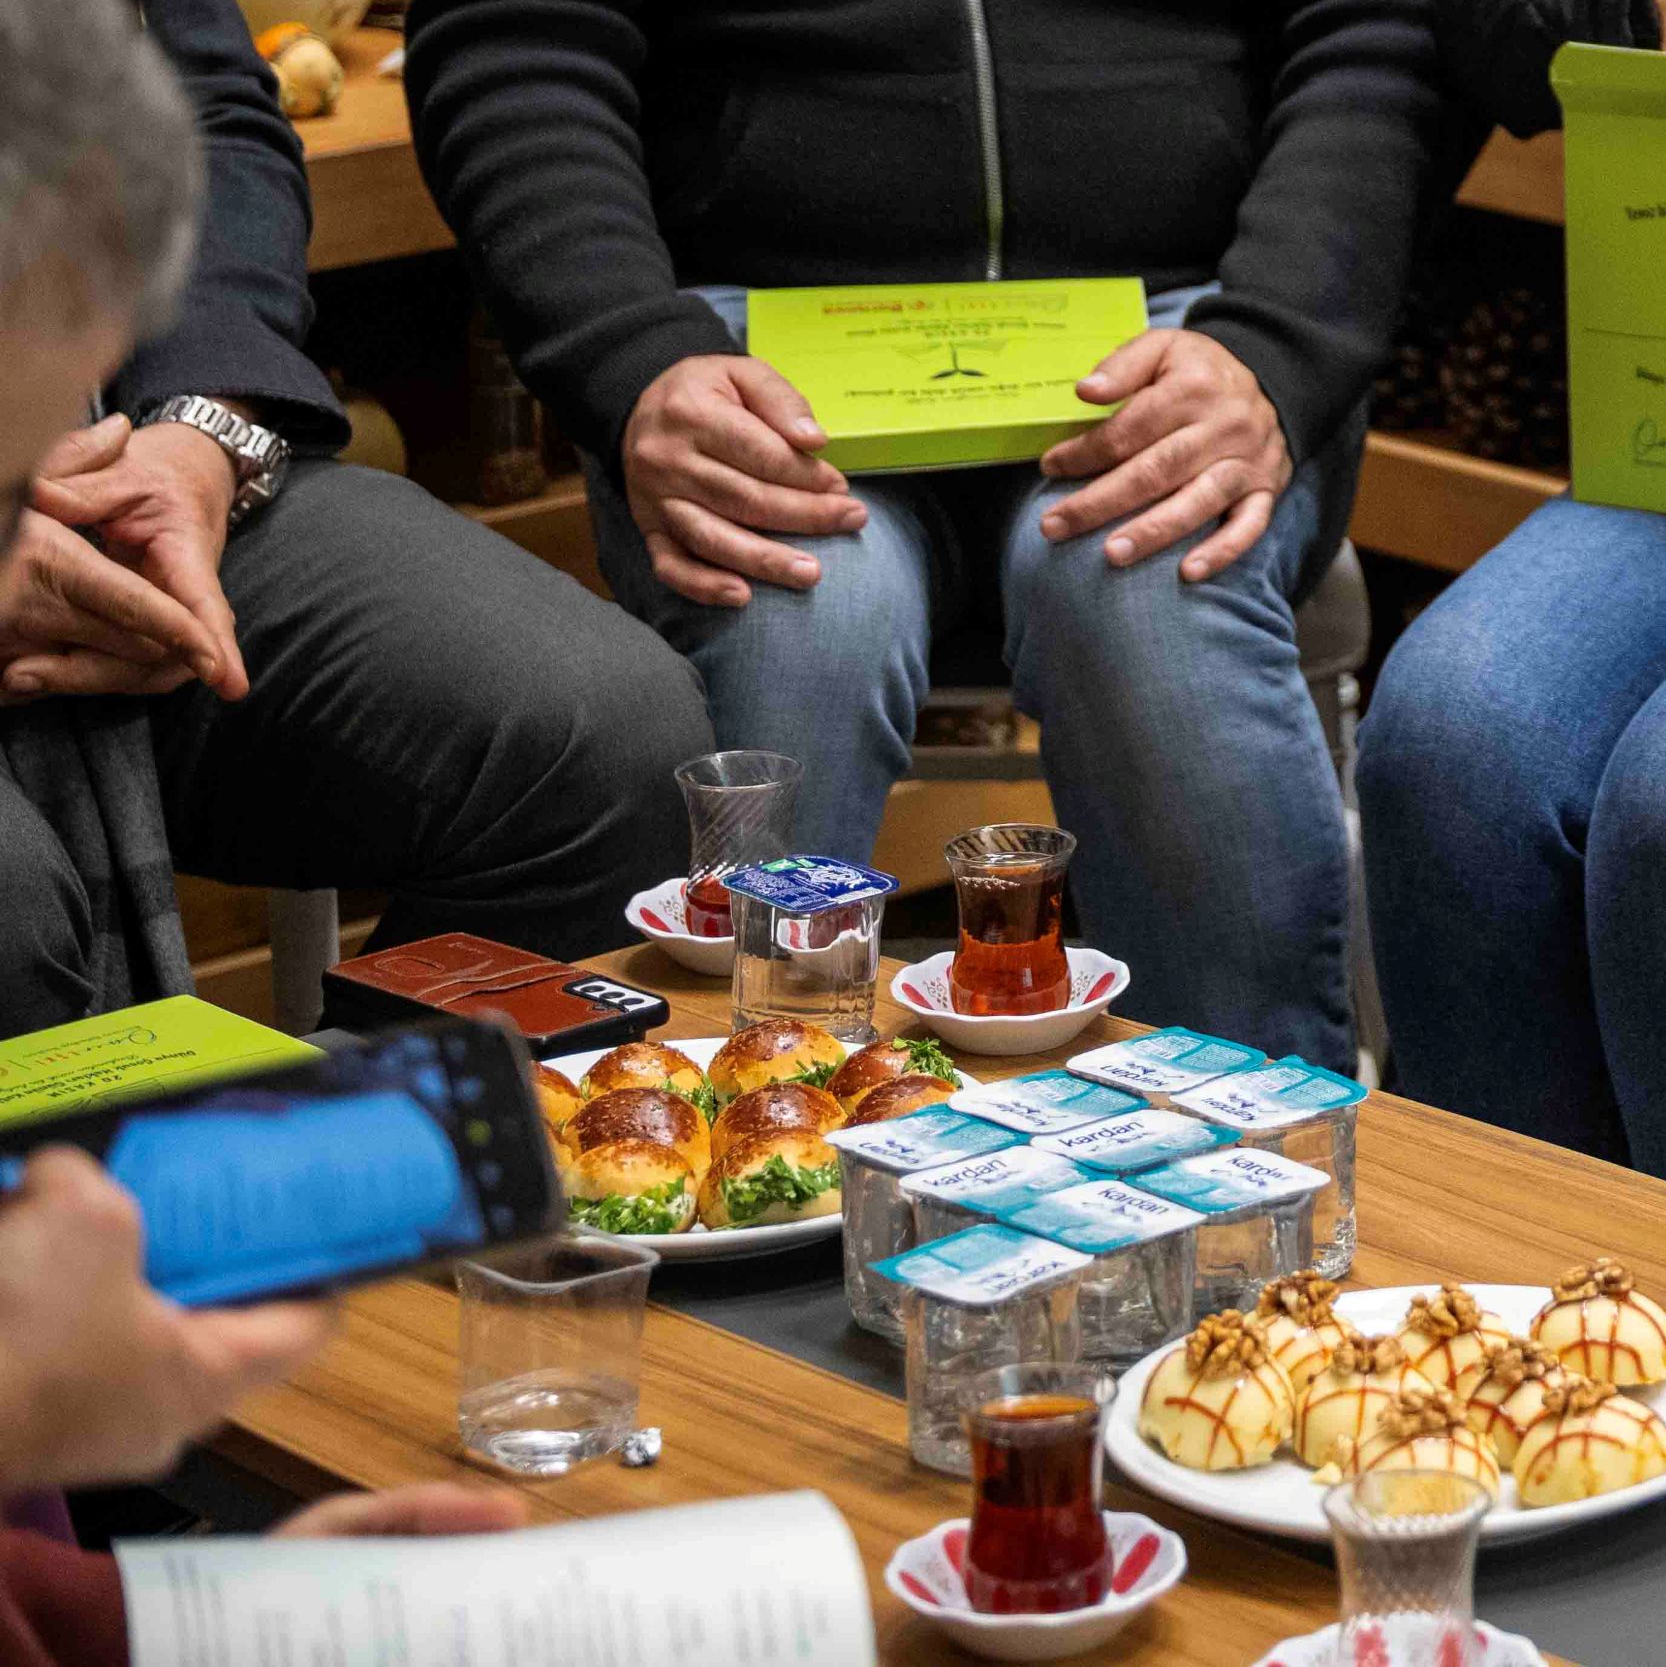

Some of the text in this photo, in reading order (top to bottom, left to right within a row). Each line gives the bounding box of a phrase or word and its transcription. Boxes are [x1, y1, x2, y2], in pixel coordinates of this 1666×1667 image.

[153, 1049, 196, 1063] Dünya
[46, 1081, 95, 1099] KASIM
[1058, 1119, 1146, 1148] kardan
[922, 1156, 1008, 1187] kardan
[1097, 1185, 1170, 1215] kardan
